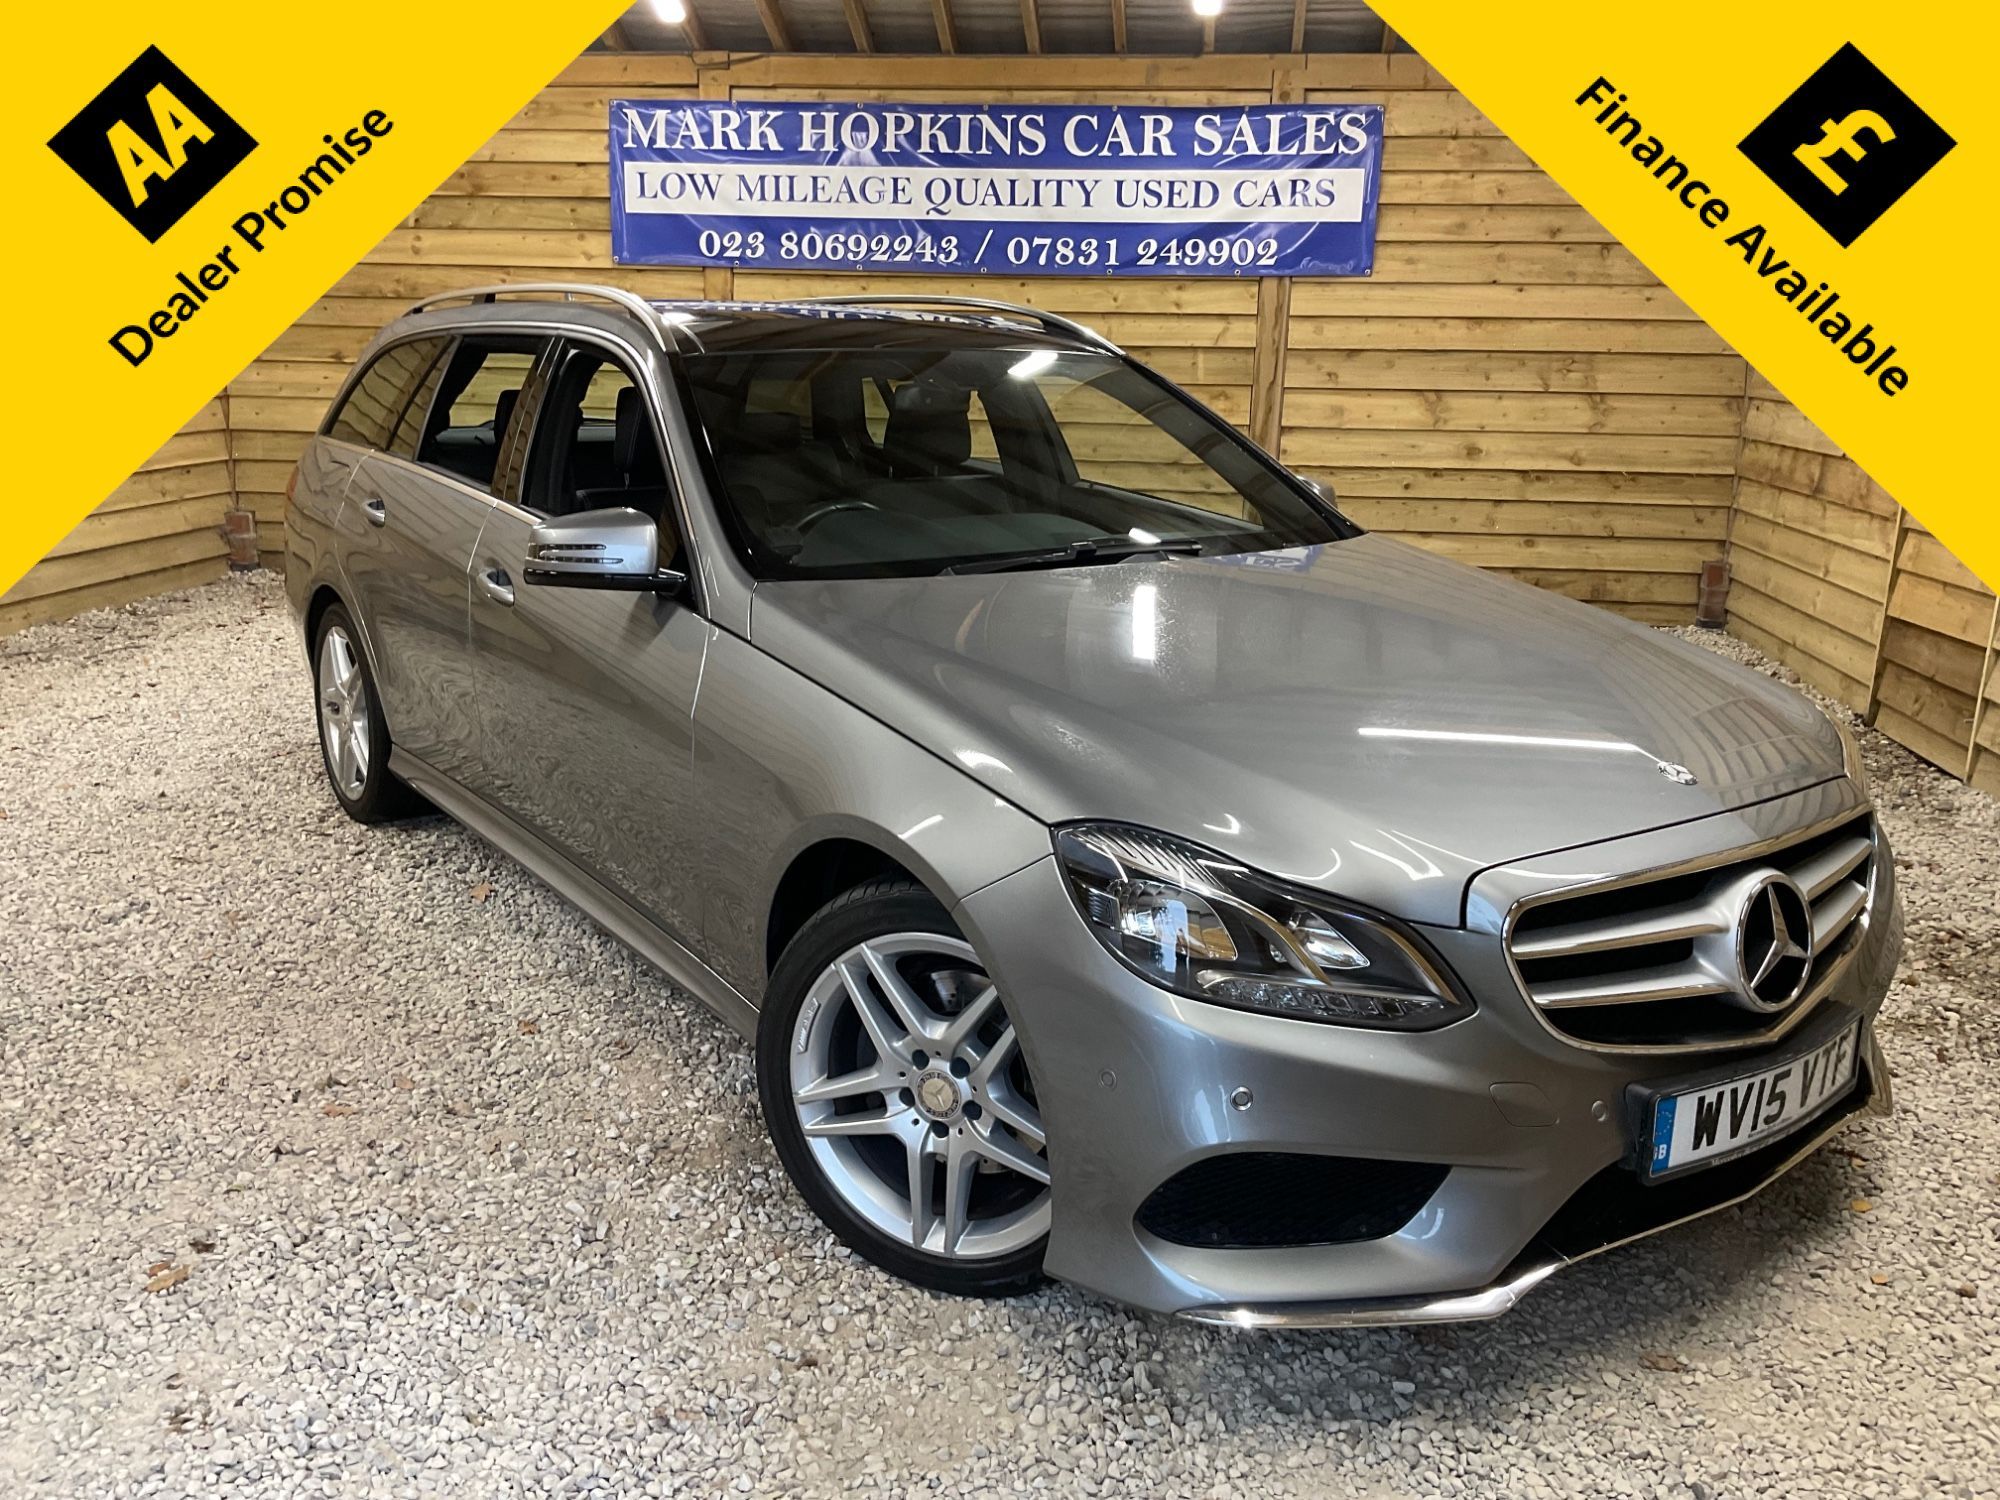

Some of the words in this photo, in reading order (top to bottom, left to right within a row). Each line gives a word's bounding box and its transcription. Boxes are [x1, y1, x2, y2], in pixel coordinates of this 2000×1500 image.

[623, 108, 784, 152] MARK
[798, 111, 1046, 156] HOPKINS
[1063, 113, 1177, 157] CAR
[1193, 112, 1367, 156] SALES
[637, 171, 723, 200] LOW
[737, 175, 912, 206] MILEAGE
[924, 178, 1100, 216] QUALITY
[1114, 178, 1219, 209] USED
[1233, 178, 1336, 208] CARS
[699, 230, 765, 259] 023
[780, 231, 959, 264] 80692243
[973, 229, 994, 264] /
[1007, 236, 1120, 266] 07831
[1136, 237, 1279, 267] 249902
[1692, 1068, 1792, 1151] WV15
[1800, 1027, 1852, 1108] VTF
